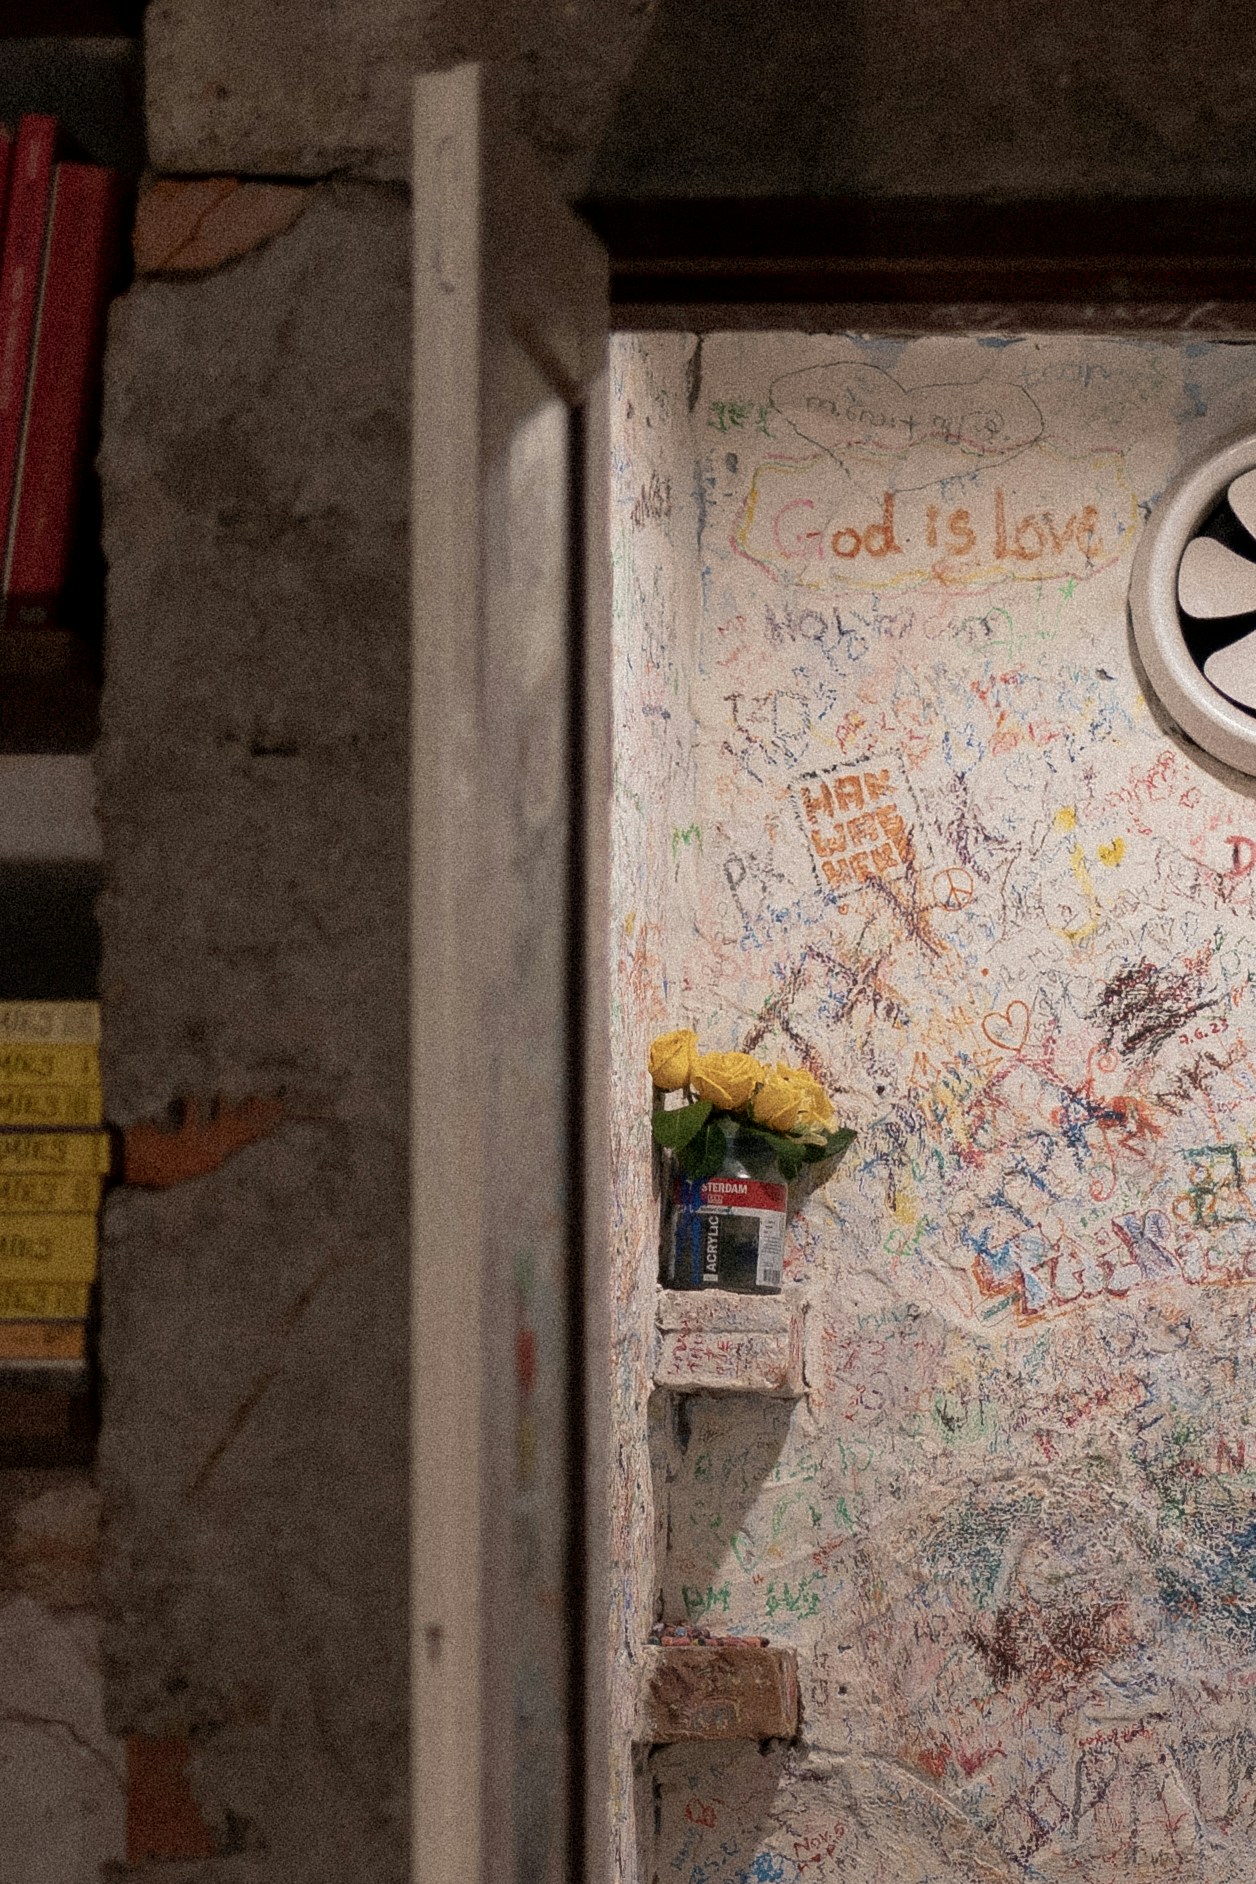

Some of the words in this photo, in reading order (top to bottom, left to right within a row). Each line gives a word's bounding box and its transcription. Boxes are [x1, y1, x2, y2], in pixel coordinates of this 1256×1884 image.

[772, 490, 901, 562] God
[926, 503, 977, 556] is
[706, 1215, 720, 1273] ACRYLIC
